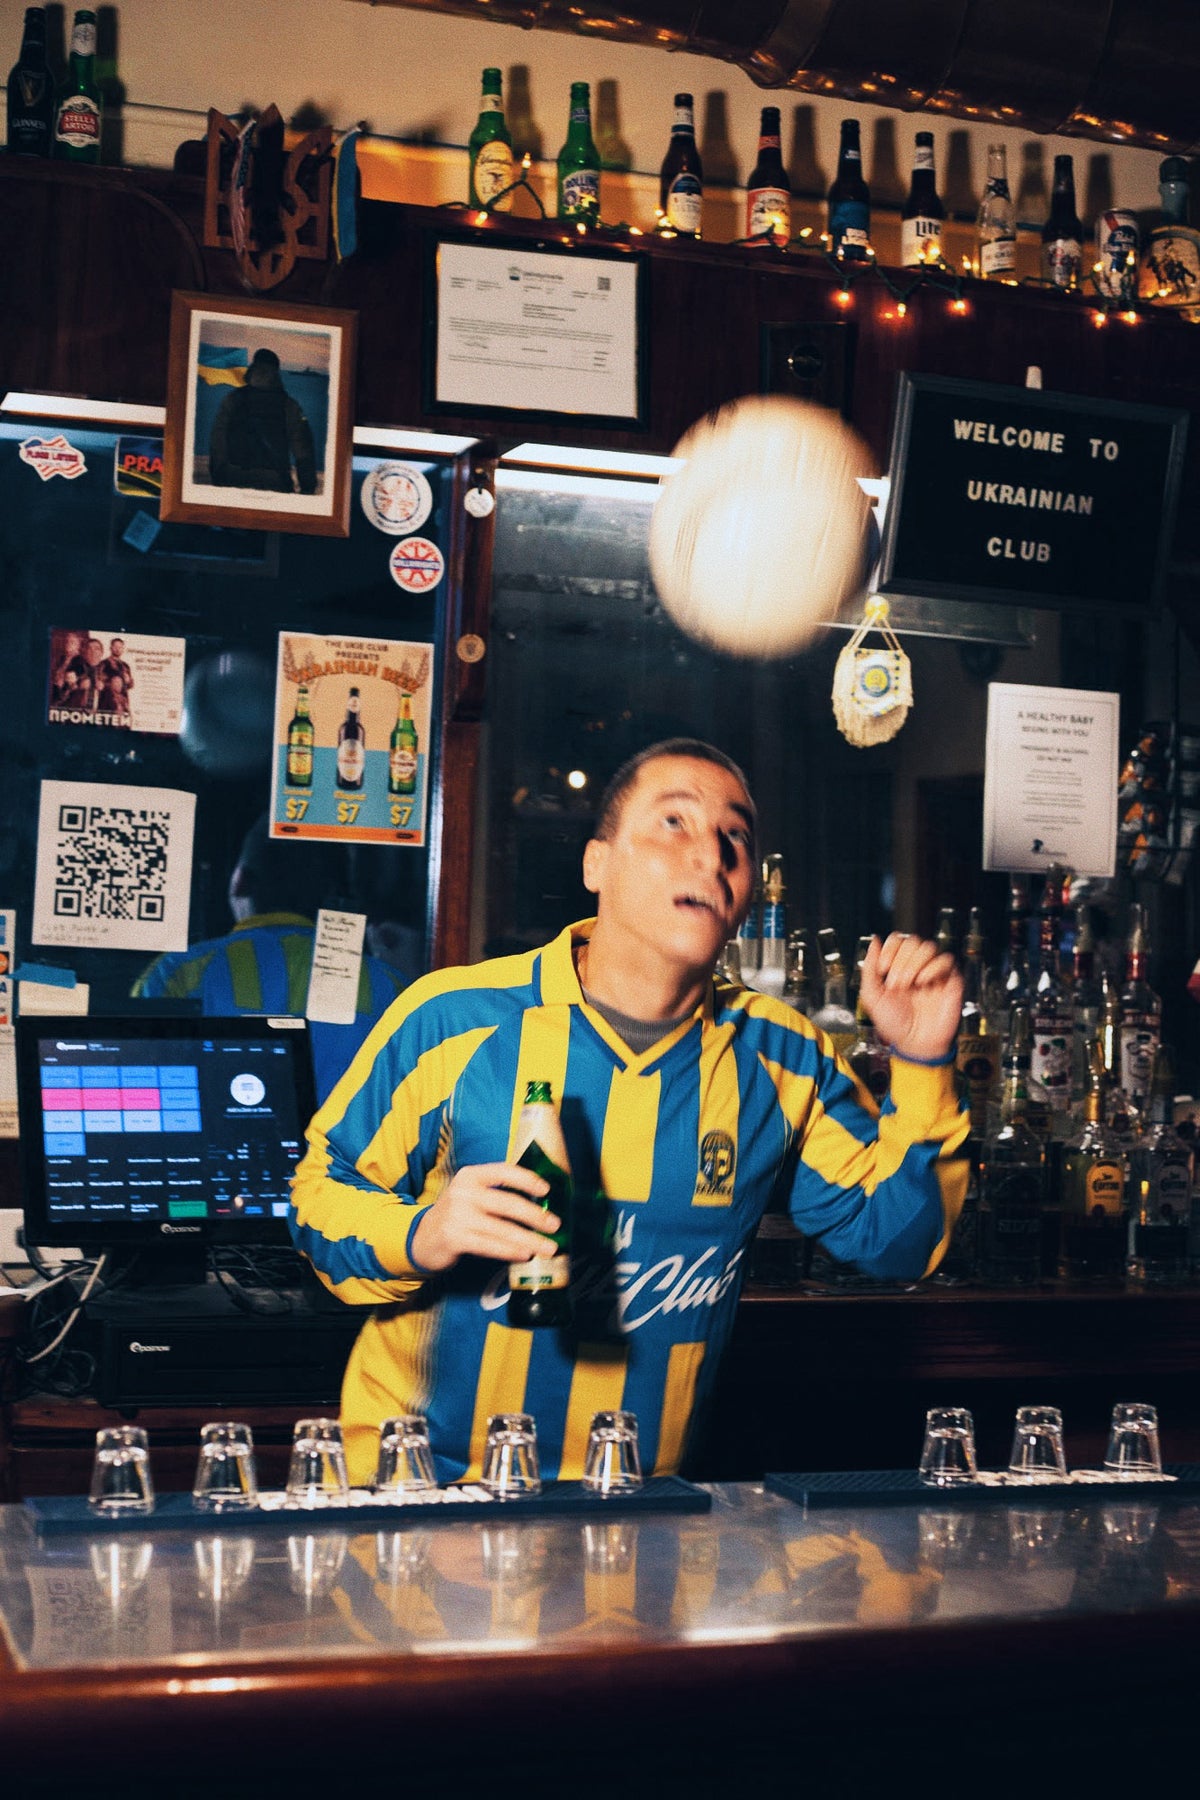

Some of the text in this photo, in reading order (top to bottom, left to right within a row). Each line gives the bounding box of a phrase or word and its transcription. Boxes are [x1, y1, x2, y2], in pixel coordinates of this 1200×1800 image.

[953, 418, 1119, 462] WELCOME TO
[966, 479, 1094, 516] UKRAINIAN
[986, 536, 1052, 563] CLUB
[325, 640, 341, 648] THE
[366, 643, 389, 652] CLUB
[335, 650, 380, 662] PRESENTS
[1070, 714, 1095, 725] BABY
[285, 797, 309, 821] $7
[337, 801, 361, 824] $7
[389, 804, 413, 828] $7
[616, 1246, 744, 1334] Club
